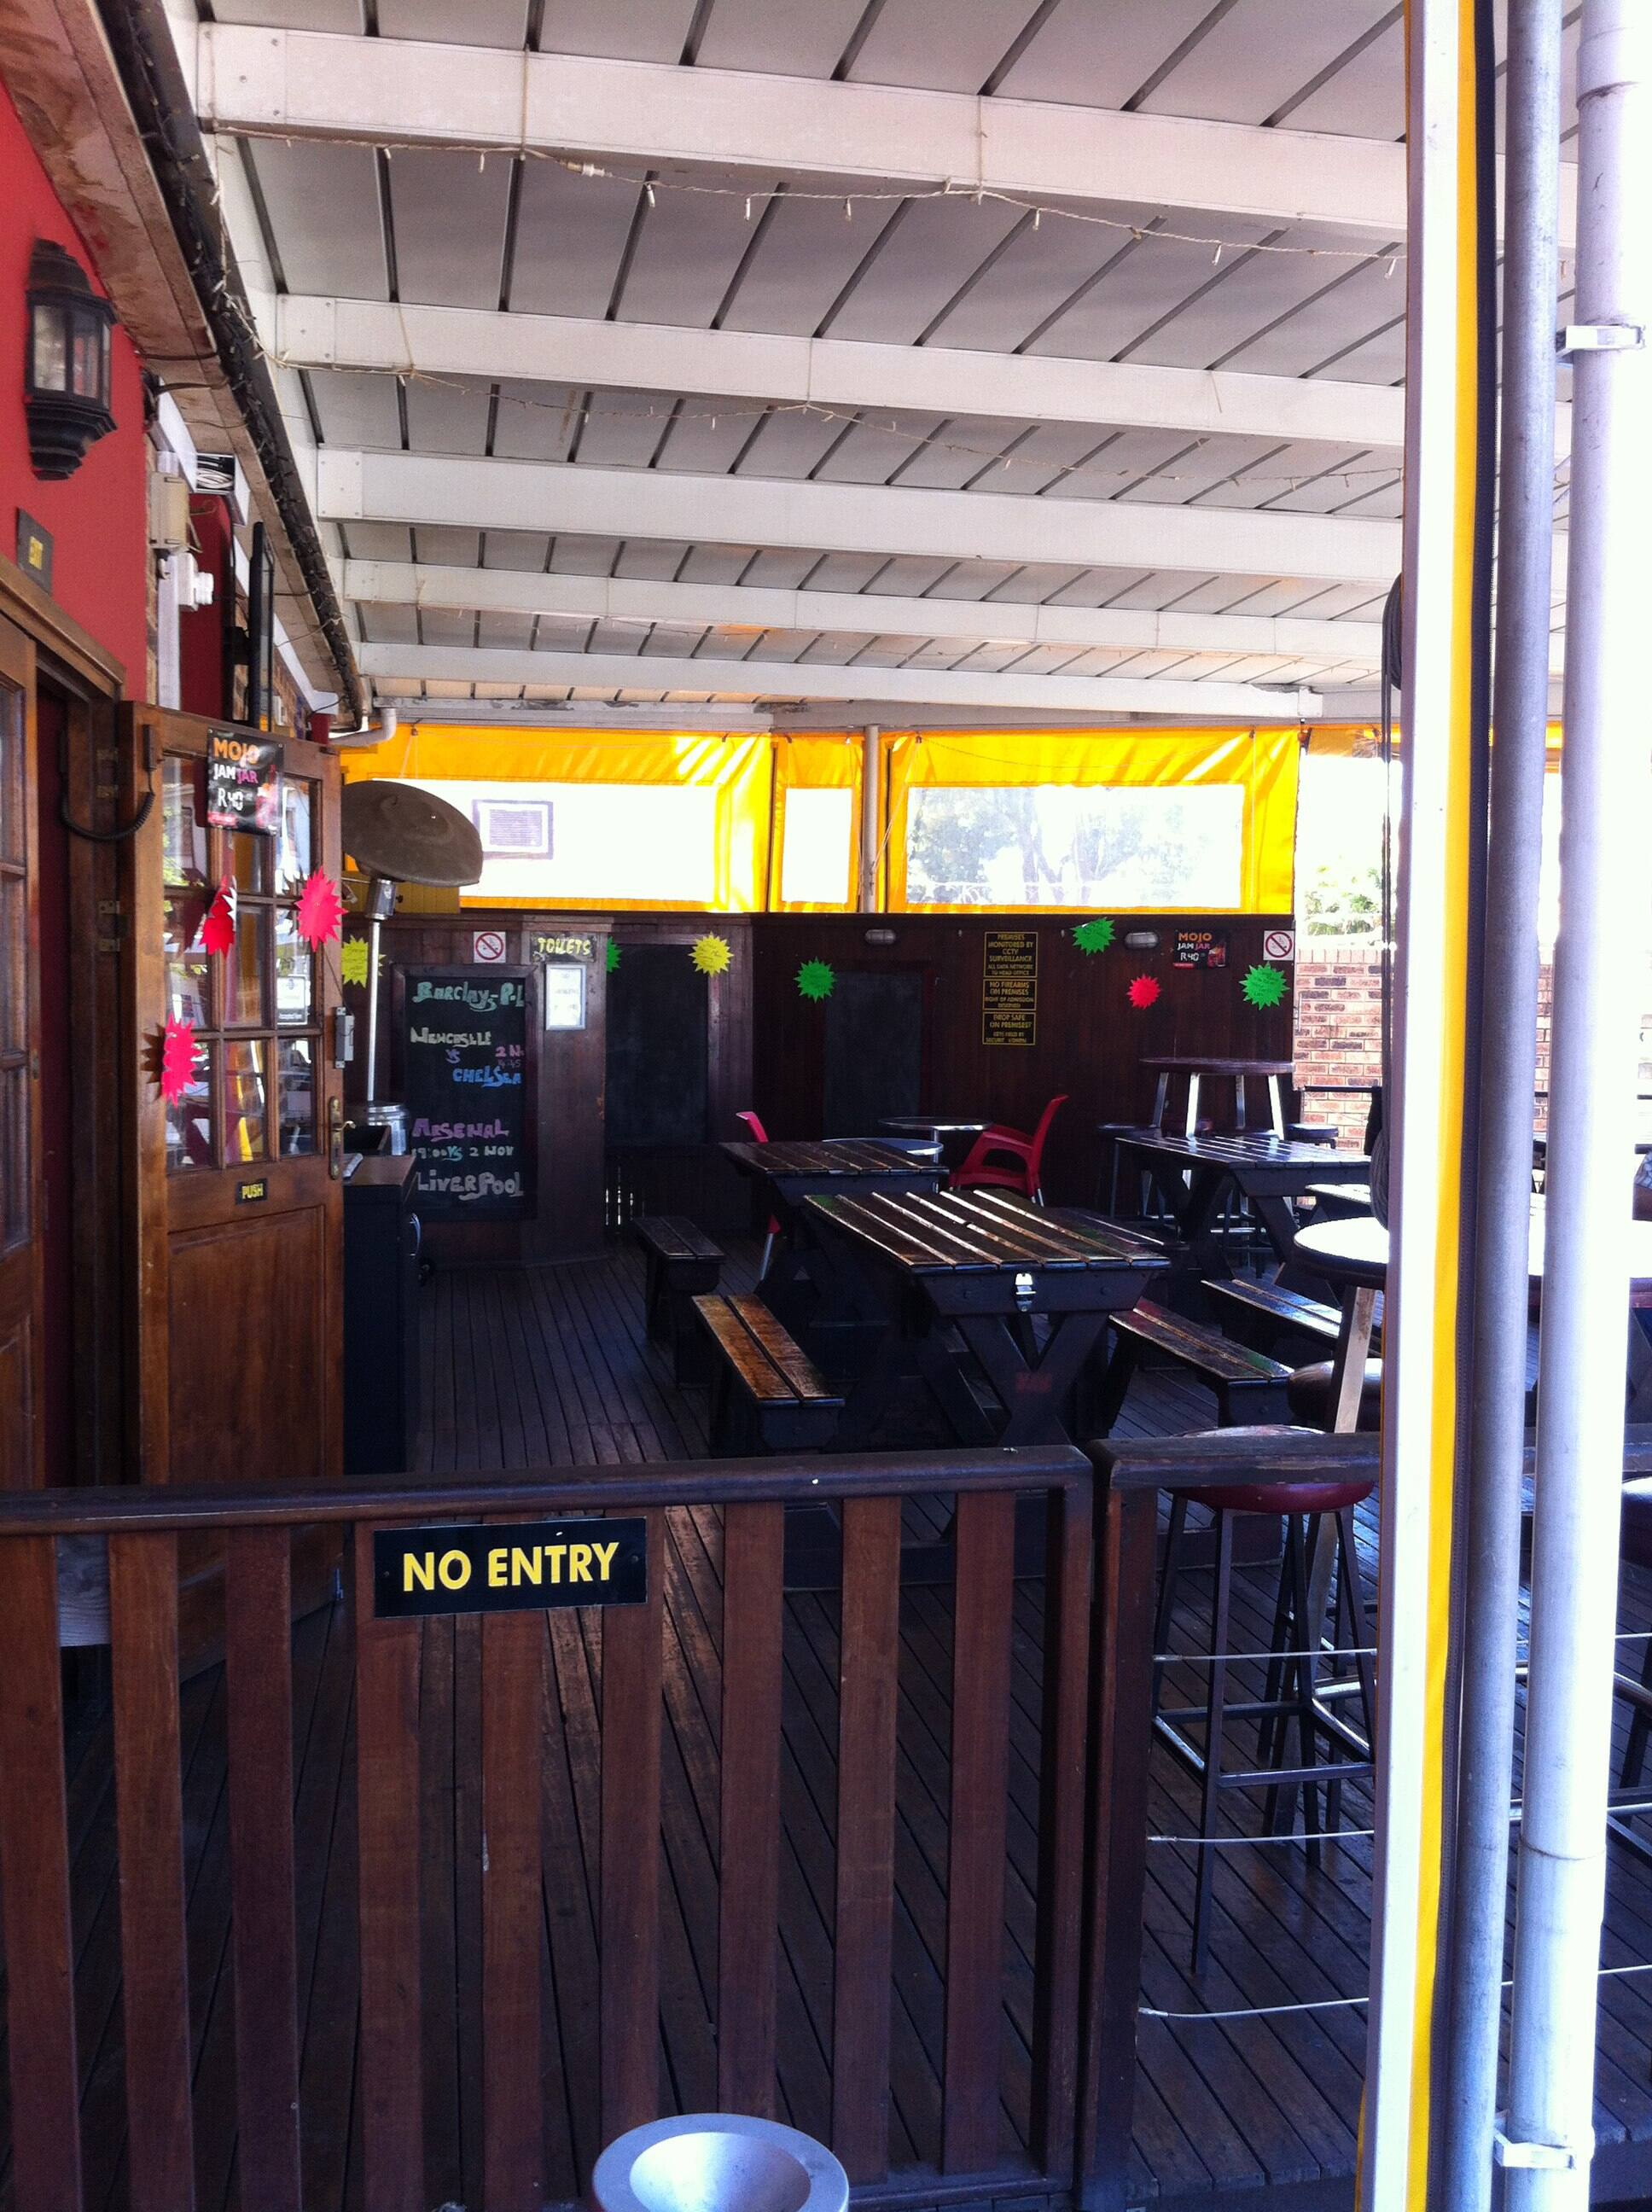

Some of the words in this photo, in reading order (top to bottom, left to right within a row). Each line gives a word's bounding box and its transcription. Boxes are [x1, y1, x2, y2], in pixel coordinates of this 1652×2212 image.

[212, 736, 260, 768] MOJO
[213, 763, 236, 780] JAM
[236, 768, 259, 784] JAR
[1178, 932, 1213, 943] MOJO
[538, 937, 591, 955] TOILETS
[1178, 942, 1195, 951] JAM
[495, 1045, 507, 1057] 2
[469, 1146, 479, 1157] 2
[241, 1183, 264, 1199] PUSH
[403, 1548, 472, 1592] NO
[487, 1541, 620, 1588] ENTRY
